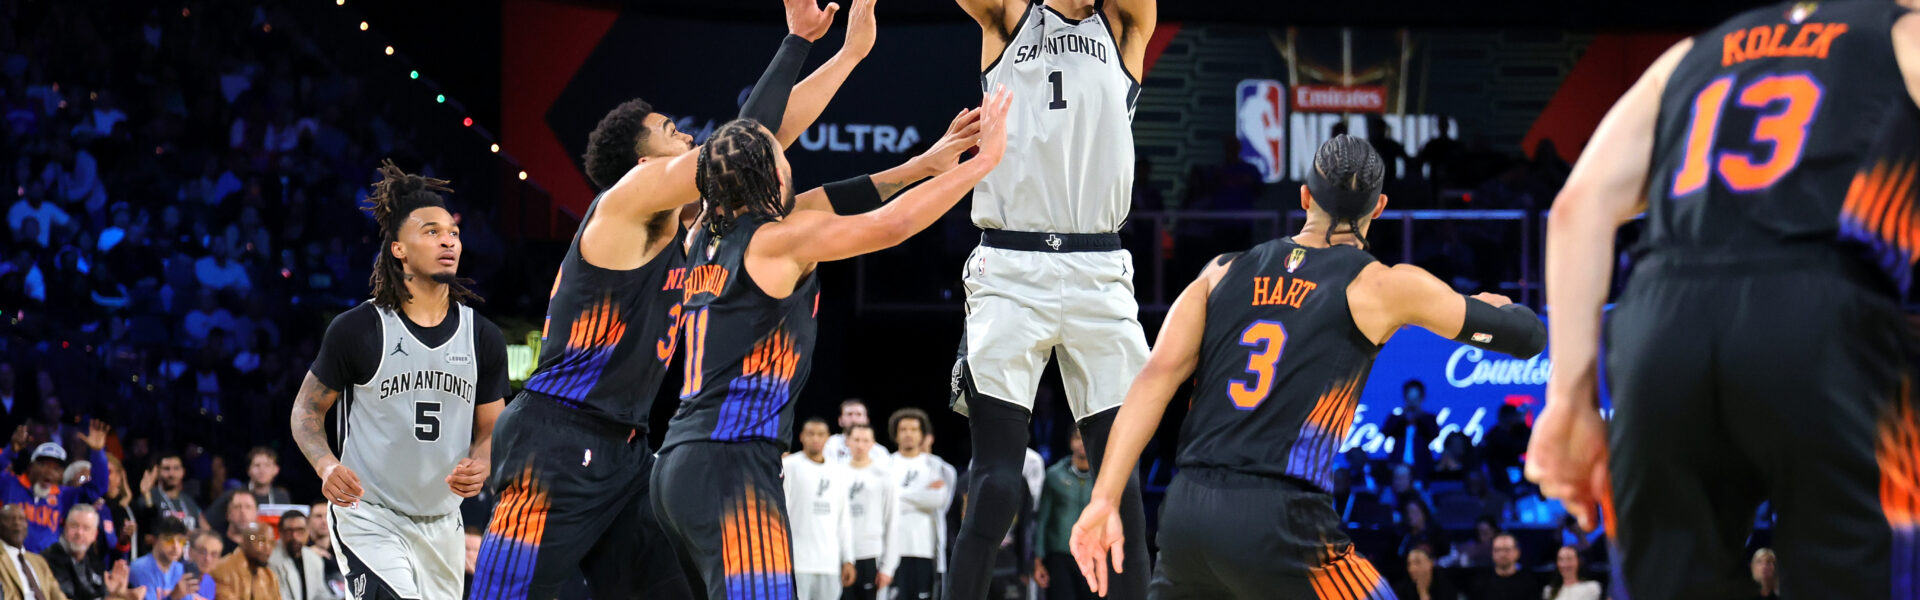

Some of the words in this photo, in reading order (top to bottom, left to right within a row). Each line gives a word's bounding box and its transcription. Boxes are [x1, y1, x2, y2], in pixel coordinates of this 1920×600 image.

[1722, 23, 1848, 67] KOLEK
[1048, 70, 1067, 110] 1
[1297, 86, 1382, 108] Emirates
[800, 123, 920, 152] ULTRA
[1669, 71, 1825, 199] 13
[1252, 277, 1317, 309] HART
[680, 305, 709, 400] 11
[1227, 319, 1288, 411] 3
[380, 372, 411, 399] SAN
[414, 370, 473, 404] ANTONIO
[415, 401, 442, 442] 5
